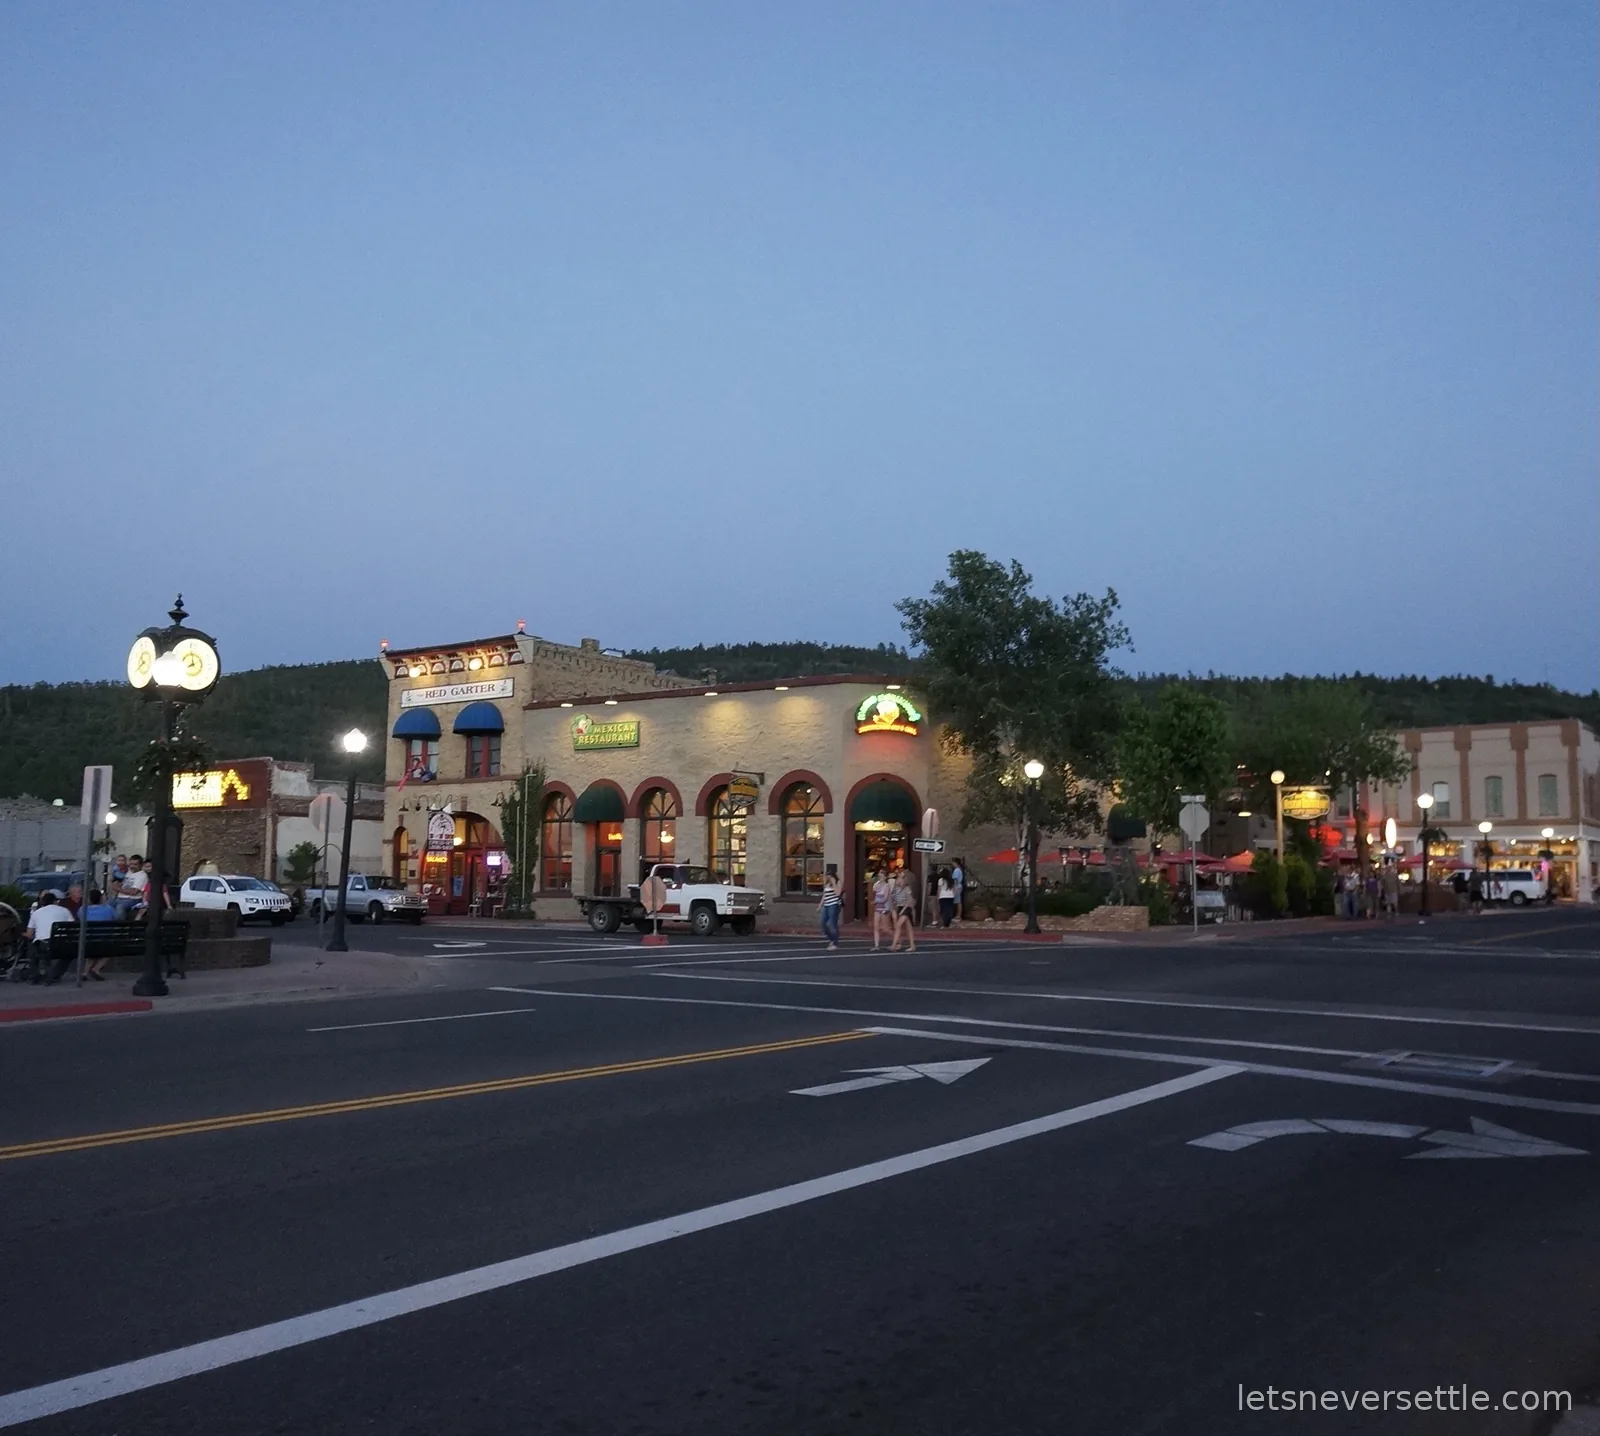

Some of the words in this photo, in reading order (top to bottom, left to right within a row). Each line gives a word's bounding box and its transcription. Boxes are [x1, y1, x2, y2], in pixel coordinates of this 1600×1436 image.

[425, 689, 447, 699] RED
[450, 683, 496, 696] GARTER
[593, 723, 636, 735] MEXICAN
[578, 732, 637, 745] RESTAURANT
